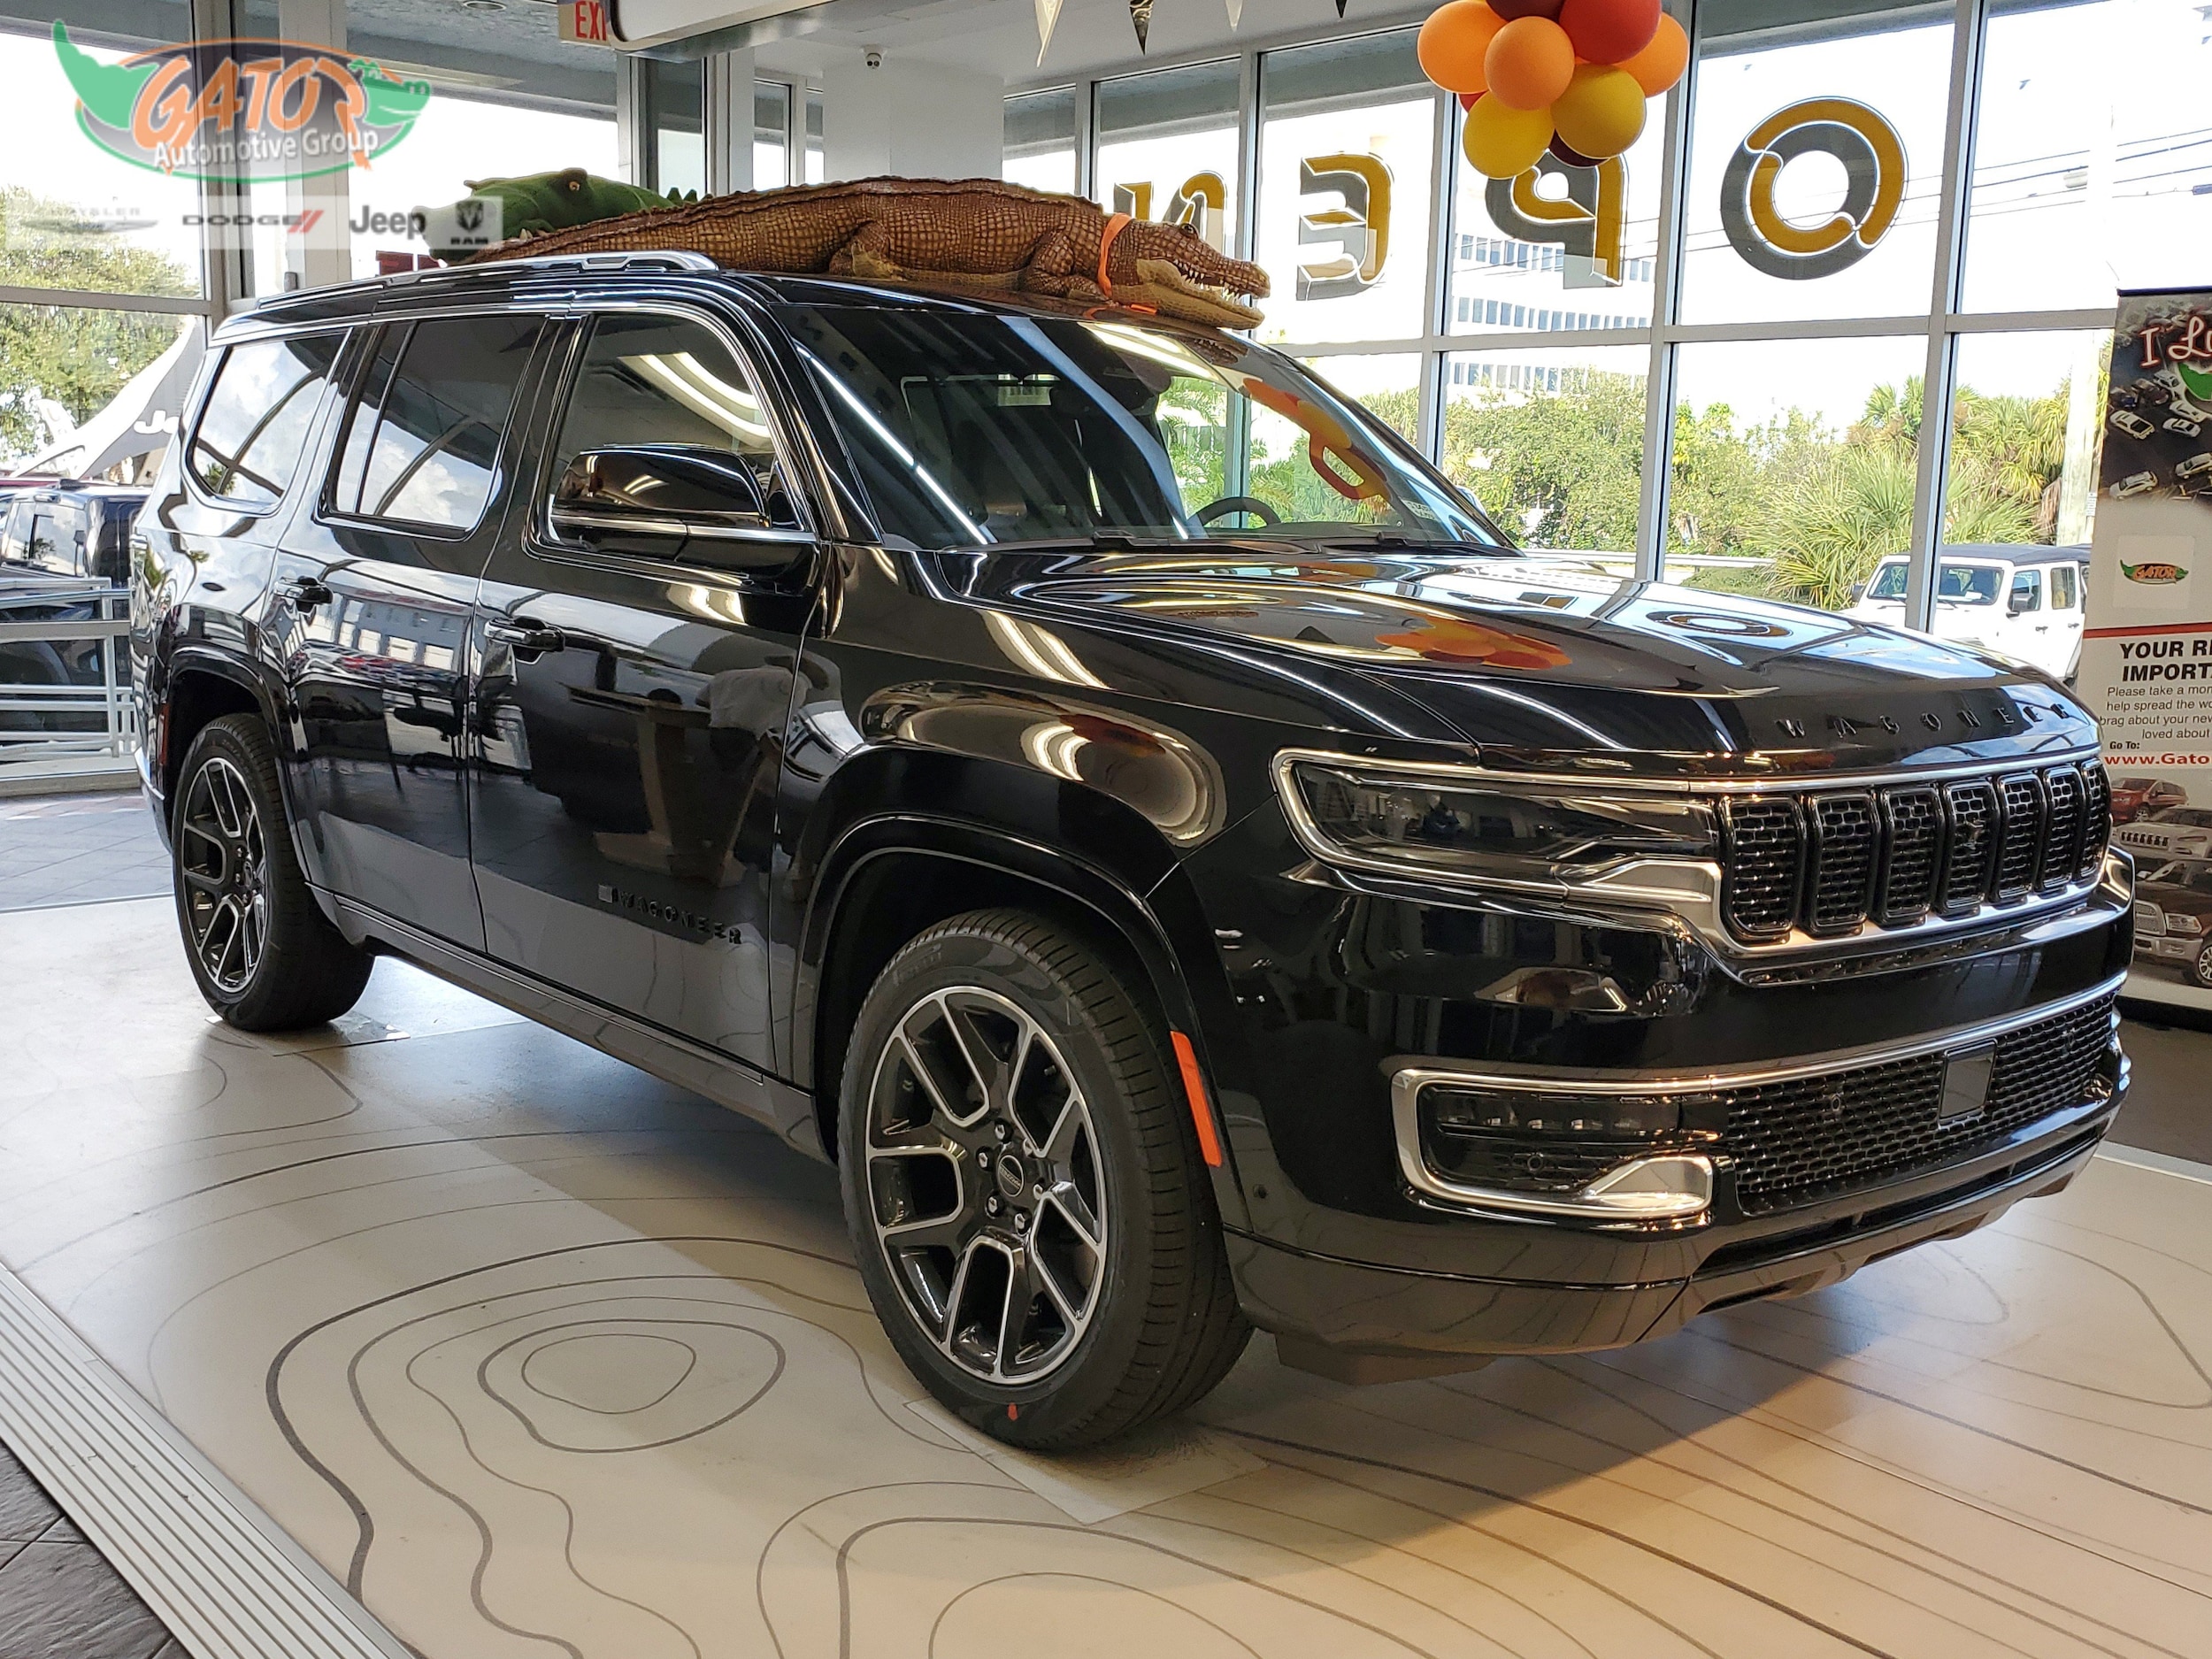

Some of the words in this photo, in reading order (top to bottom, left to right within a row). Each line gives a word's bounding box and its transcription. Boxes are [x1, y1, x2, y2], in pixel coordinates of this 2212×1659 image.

[575, 1, 607, 41] EXI
[2140, 327, 2160, 367] I
[2133, 565, 2177, 581] GATOR
[2119, 641, 2184, 659] YOUR
[2123, 662, 2212, 682] IMPORT
[2108, 686, 2146, 697] Please
[2149, 685, 2173, 695] take
[2107, 702, 2131, 713] help
[2134, 700, 2173, 712] spread
[2177, 699, 2195, 709] the
[1775, 703, 2070, 739] WAGONEER
[2101, 716, 2124, 727] brag
[2128, 715, 2160, 726] about
[2162, 715, 2189, 726] your
[2142, 729, 2173, 740] loved
[2176, 728, 2210, 739] about
[2109, 741, 2123, 750] Go
[2125, 741, 2140, 750] To:
[2104, 752, 2212, 766] www.Gato
[620, 889, 742, 945] WAGONEER
